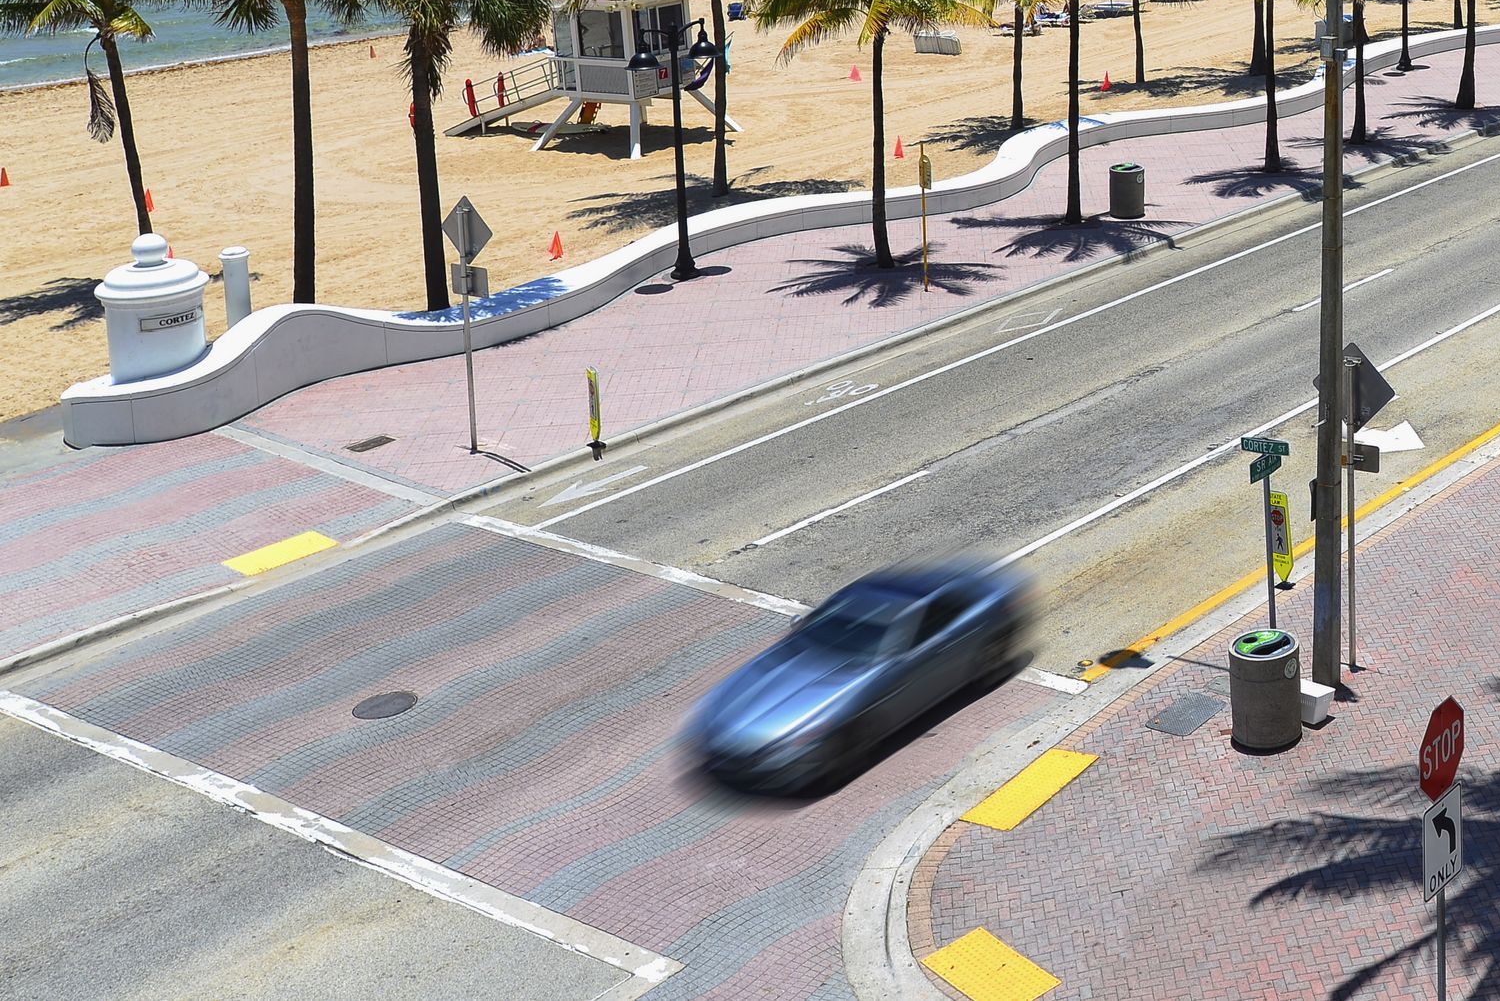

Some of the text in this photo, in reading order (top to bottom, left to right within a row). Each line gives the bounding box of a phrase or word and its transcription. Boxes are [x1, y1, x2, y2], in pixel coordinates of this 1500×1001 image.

[159, 312, 194, 326] CORTEZ
[1243, 439, 1286, 453] CORTEZ ST
[1256, 460, 1266, 472] SR
[1423, 719, 1461, 780] STOP
[1430, 854, 1457, 892] ONLY
